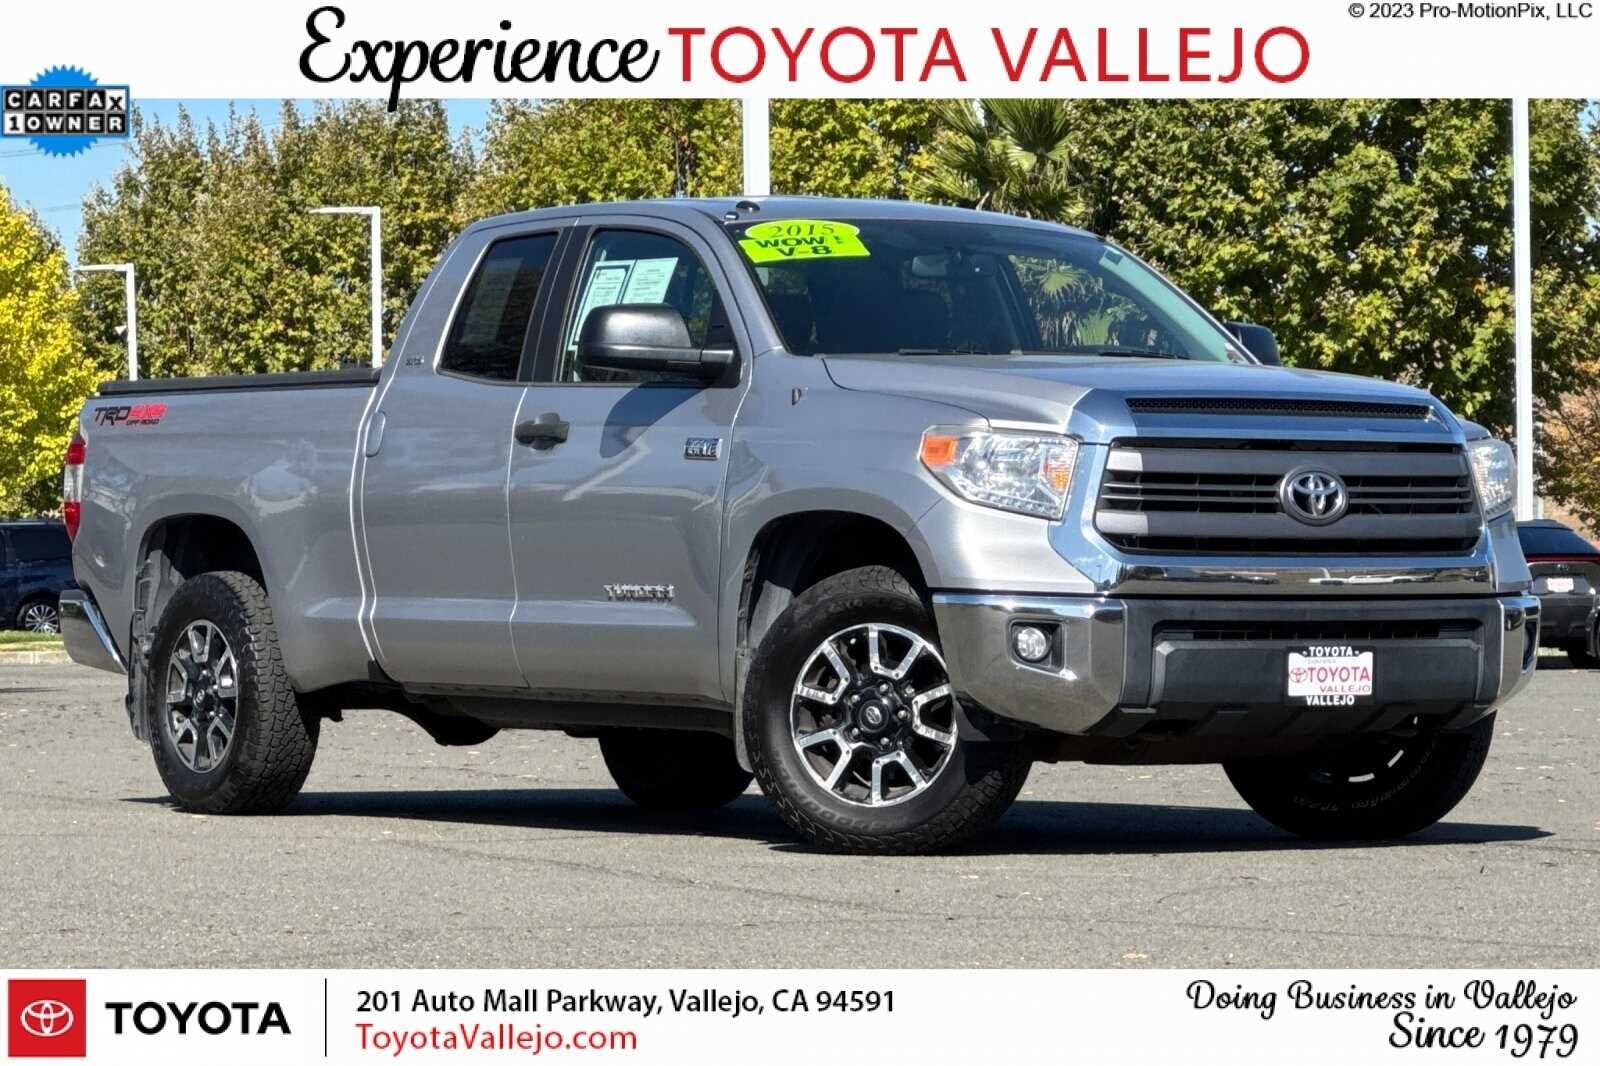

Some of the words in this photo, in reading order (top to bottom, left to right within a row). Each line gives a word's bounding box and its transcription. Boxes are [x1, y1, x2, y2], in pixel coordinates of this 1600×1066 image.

[768, 223, 835, 238] 2015
[776, 245, 833, 257] V-8
[95, 406, 132, 426] TRD
[1309, 646, 1353, 657] TOYOTA
[1307, 666, 1371, 682] TOYOTA
[1319, 685, 1372, 694] VALLEJO
[1306, 695, 1356, 706] VALLEJO
